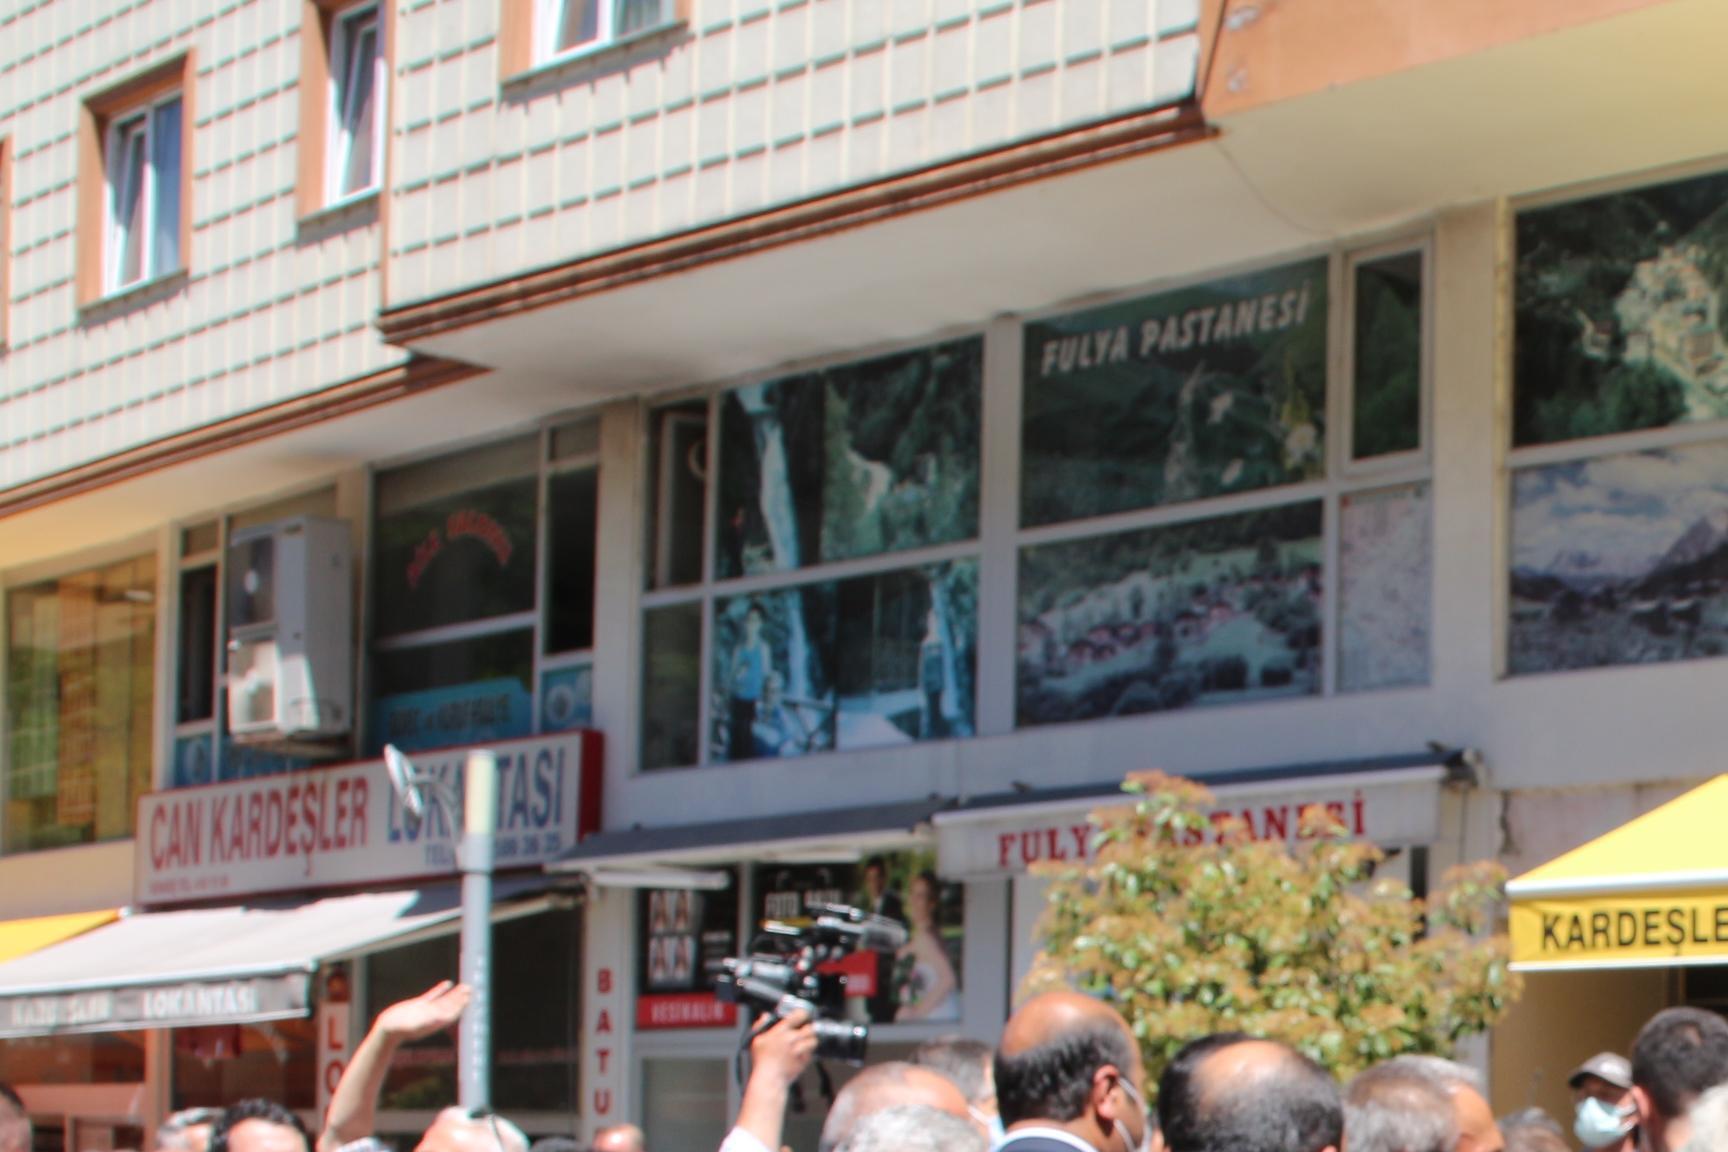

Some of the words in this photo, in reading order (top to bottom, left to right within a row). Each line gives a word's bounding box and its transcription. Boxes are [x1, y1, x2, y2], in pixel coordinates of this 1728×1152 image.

[1041, 324, 1129, 378] FULYA
[1139, 280, 1311, 357] PASTANESİ
[150, 797, 199, 870] CAN
[209, 777, 369, 876] KARDEŞLER
[387, 748, 566, 842] LOKATASI
[998, 823, 1108, 867] FULY
